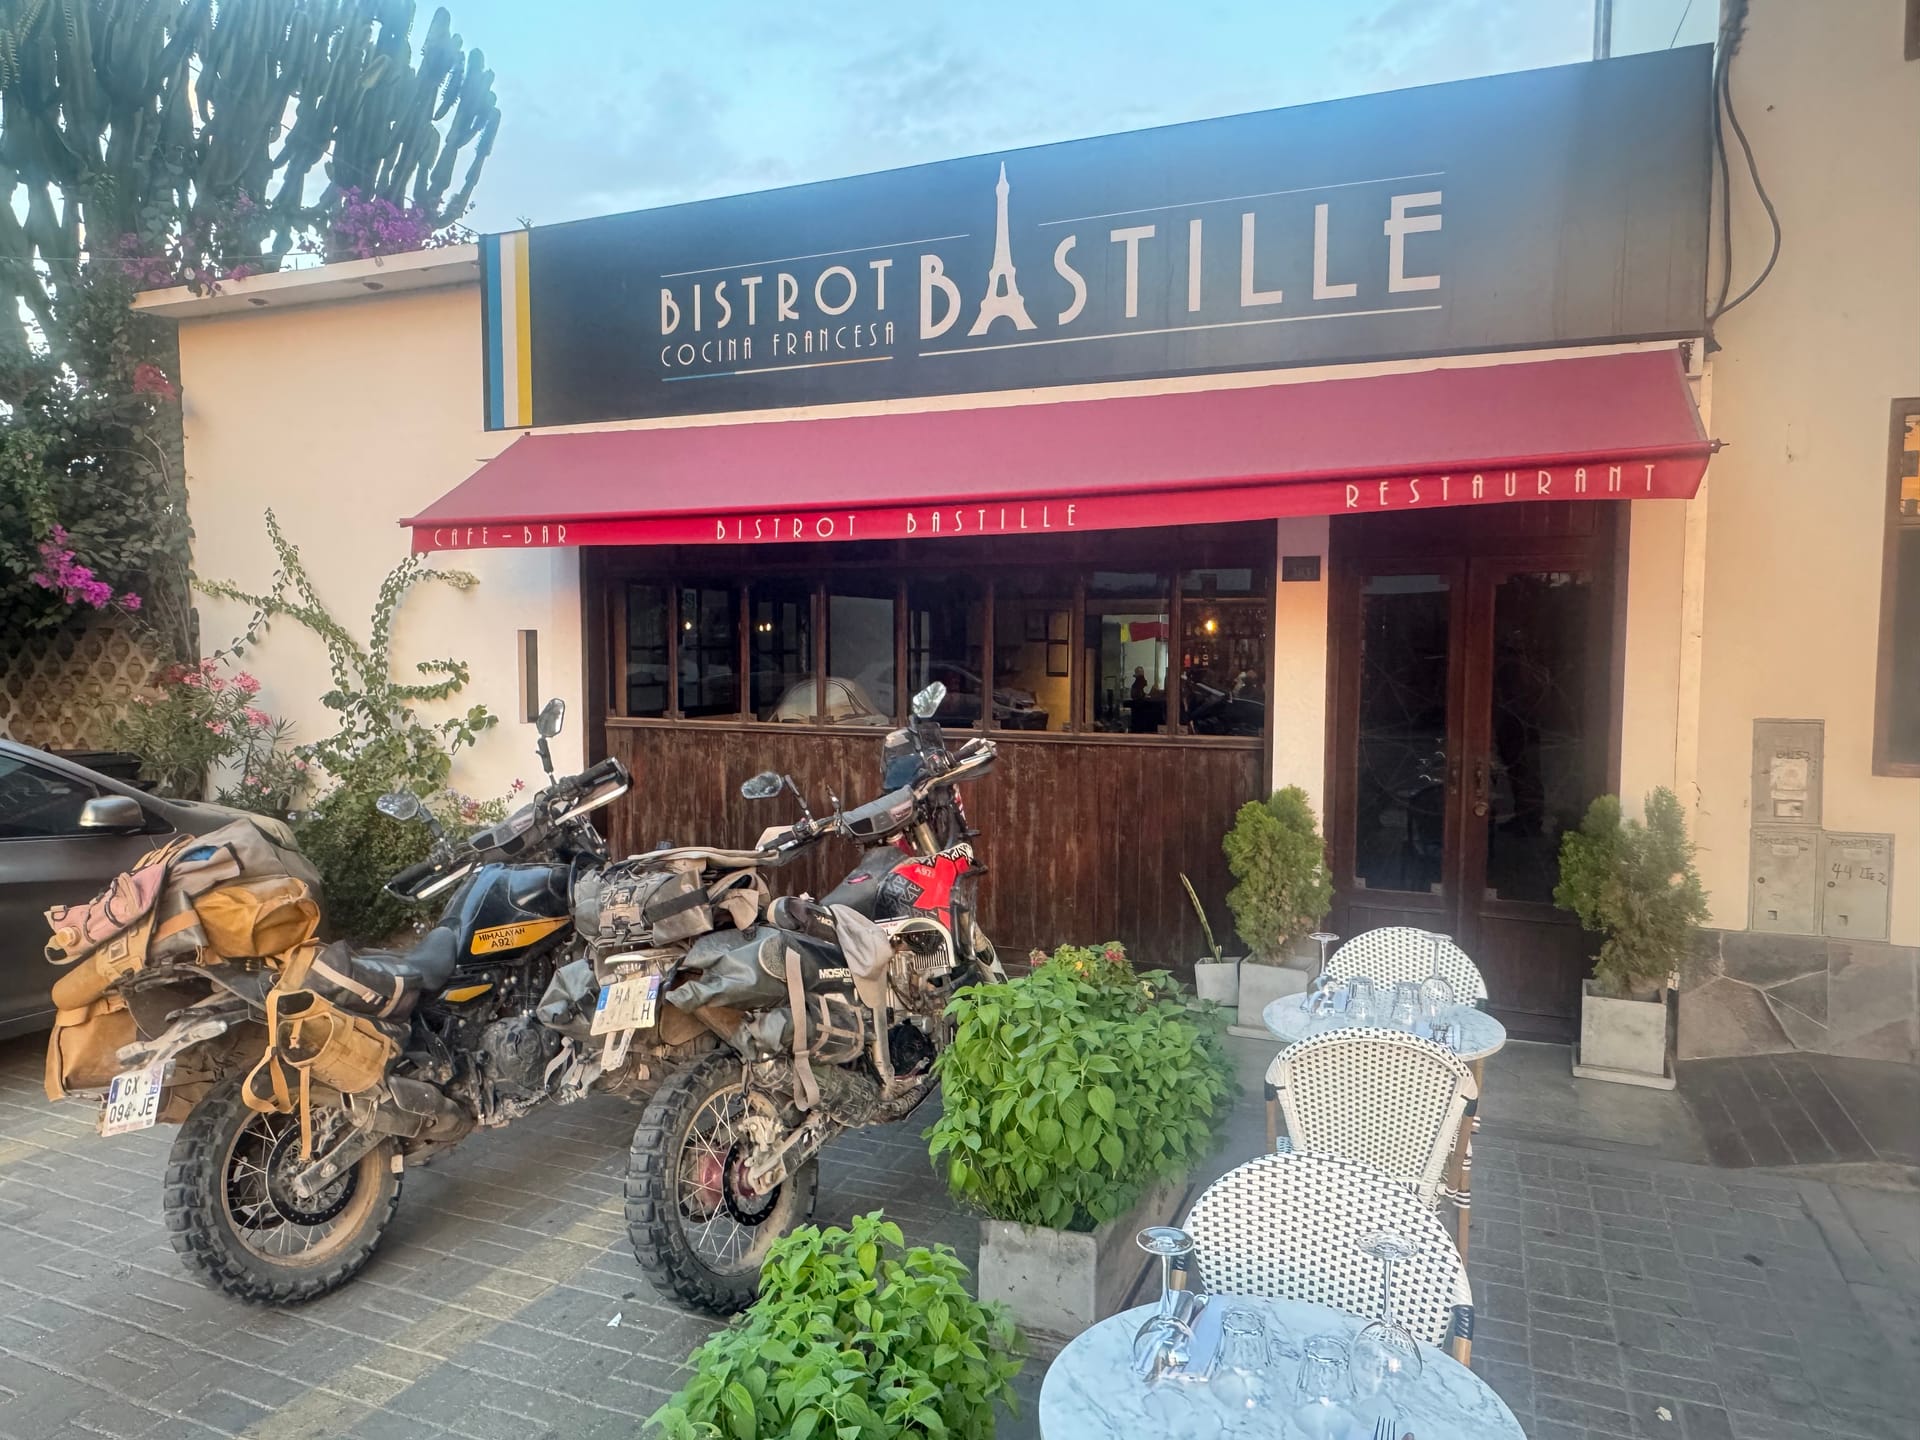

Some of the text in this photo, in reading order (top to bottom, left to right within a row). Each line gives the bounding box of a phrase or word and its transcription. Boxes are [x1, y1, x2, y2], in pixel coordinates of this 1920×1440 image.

[660, 160, 1443, 340] BISTROT BASTILLE
[660, 320, 895, 368] COCINA FRANCESA
[1345, 463, 1656, 508] RESTAURANT
[716, 504, 1077, 540] BISTROT BASTILLE
[478, 927, 526, 942] HIMALAYAN
[491, 937, 515, 949] A92
